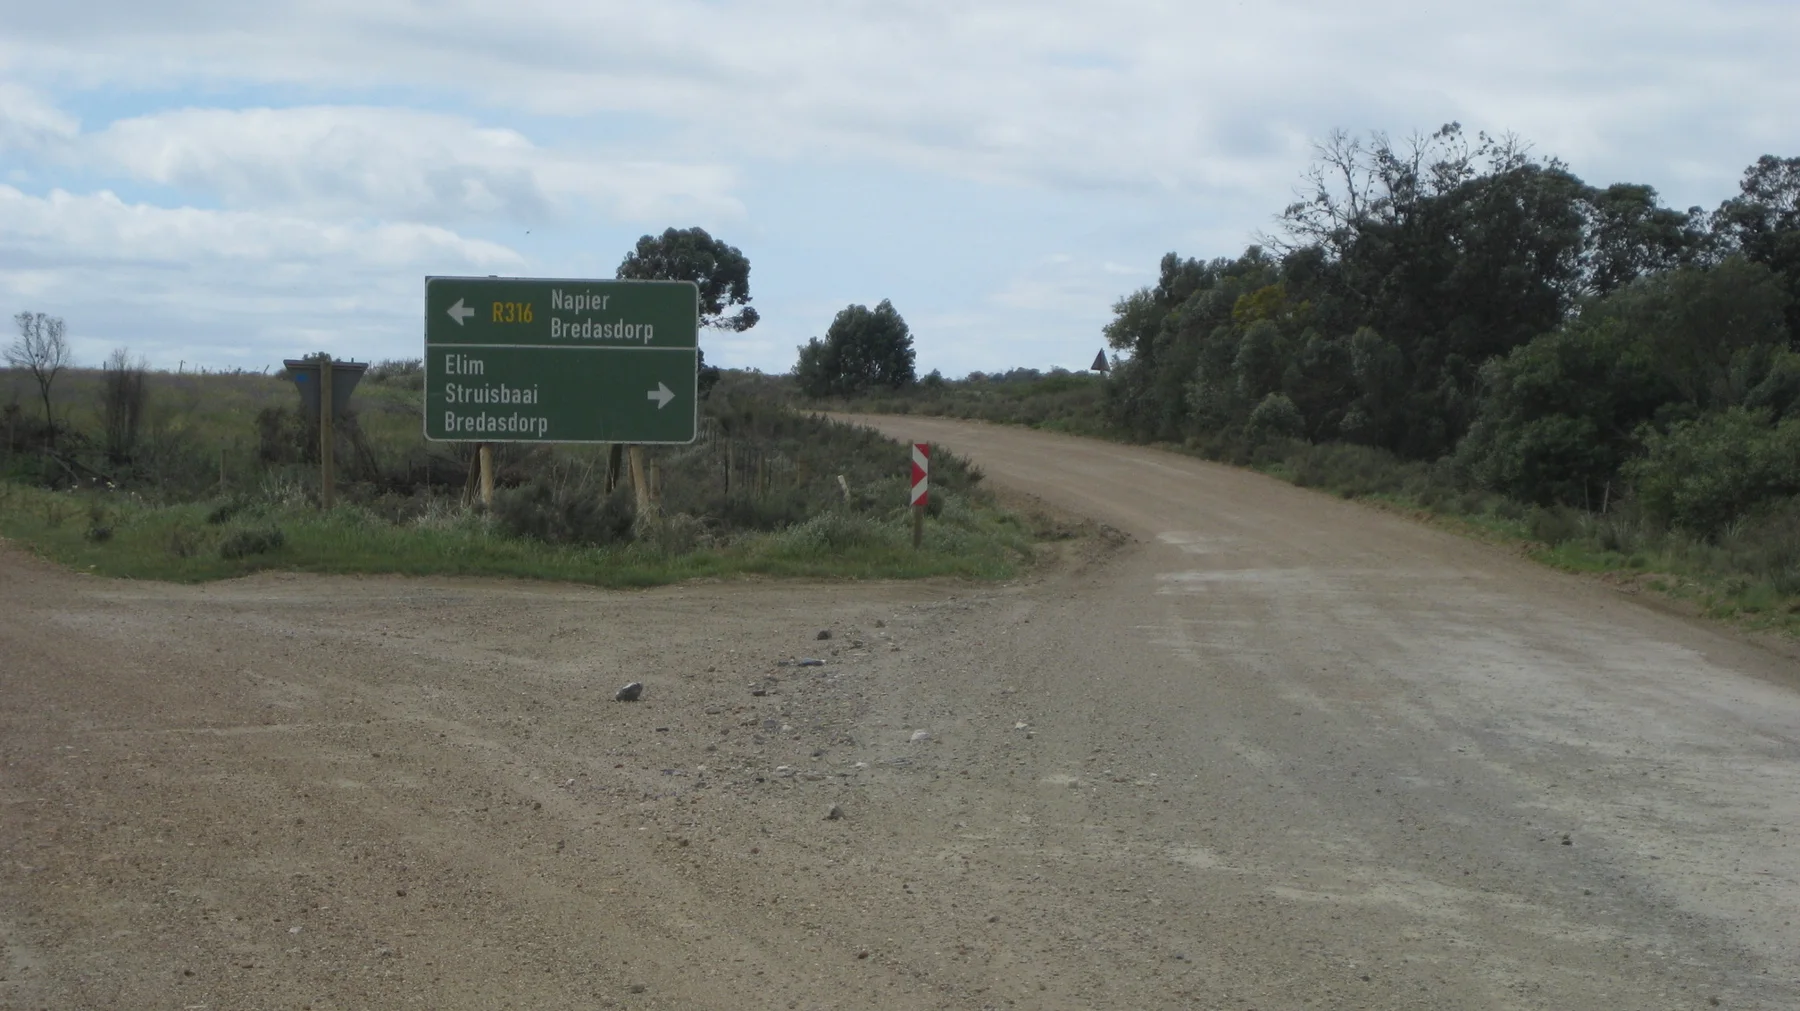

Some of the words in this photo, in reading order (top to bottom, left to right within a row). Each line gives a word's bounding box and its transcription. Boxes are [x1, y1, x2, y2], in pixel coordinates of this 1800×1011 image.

[492, 301, 534, 323] R316
[551, 289, 610, 315] Napier
[551, 317, 654, 344] Bredasdorp
[445, 354, 484, 375] Elim
[445, 382, 538, 404] Struisbaai
[445, 411, 548, 438] Bredasdorp
